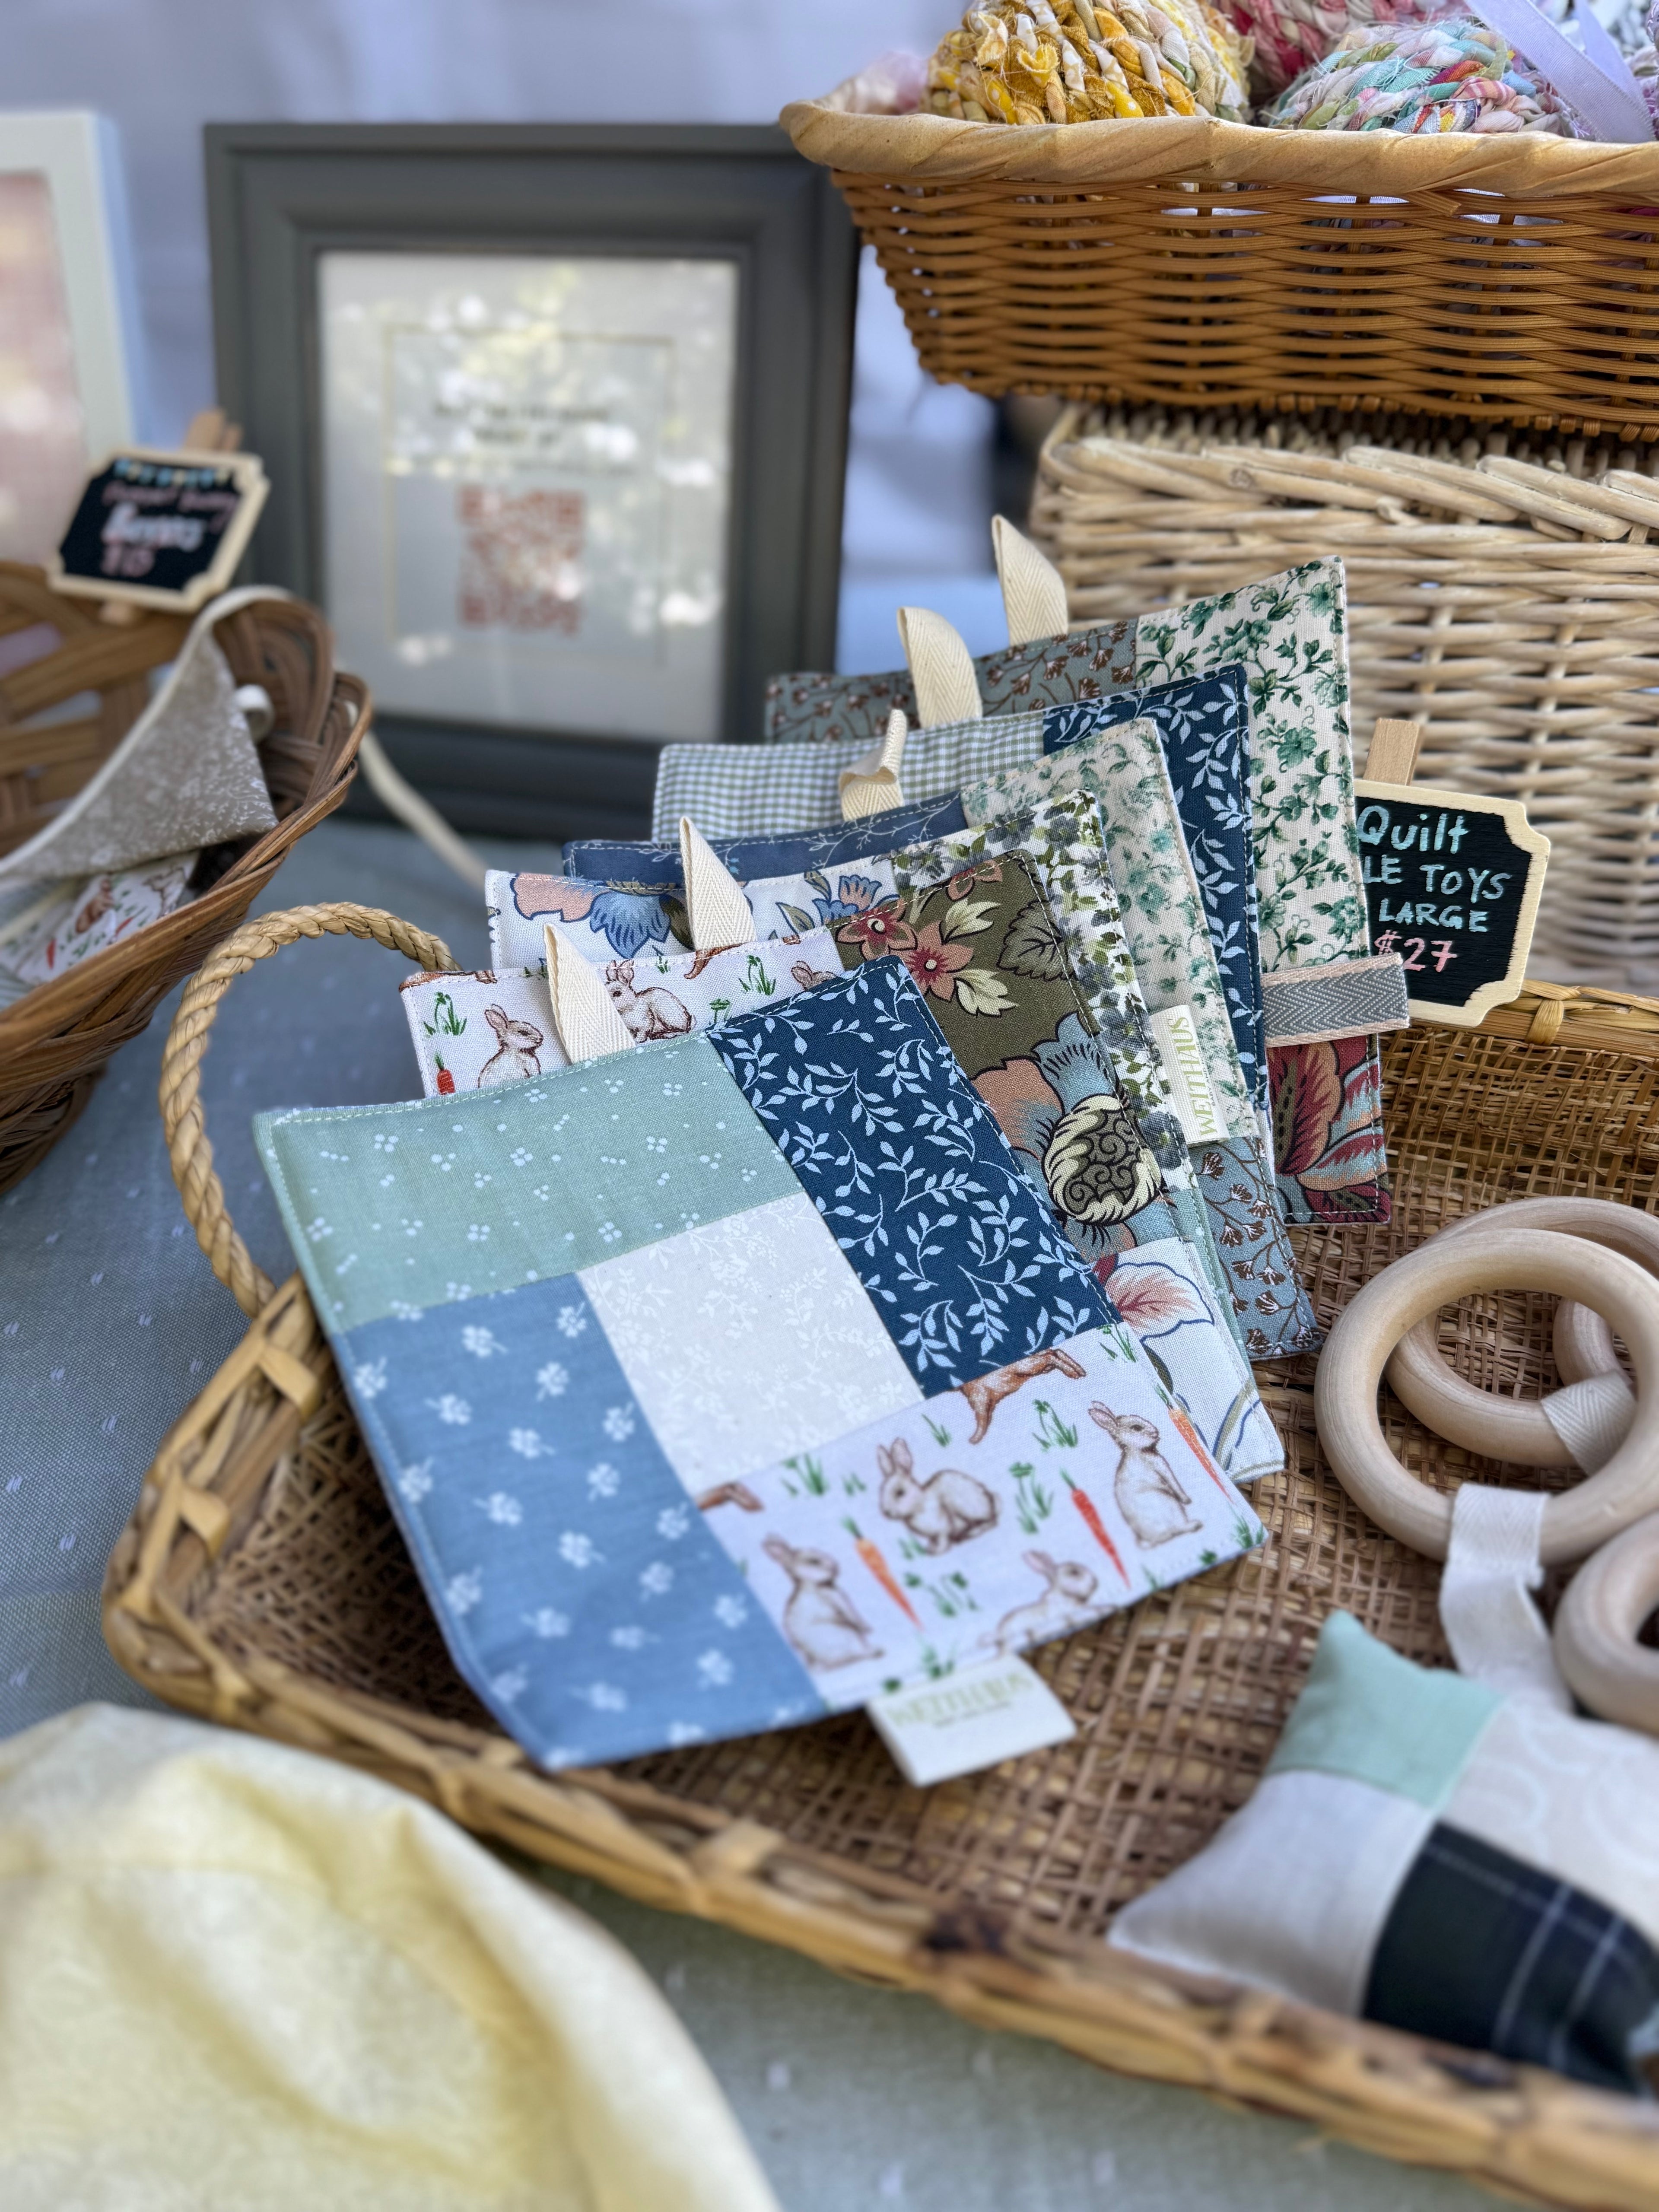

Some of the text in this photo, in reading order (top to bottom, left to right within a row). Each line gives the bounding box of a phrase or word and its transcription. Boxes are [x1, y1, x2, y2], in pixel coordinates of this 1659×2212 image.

[1357, 805, 1468, 854] Quilt
[1419, 864, 1512, 903] TOYS
[1379, 898, 1488, 932] LARGE
[1374, 929, 1458, 972] $27
[1168, 1017, 1217, 1135] WEITHAUS
[1207, 1086, 1216, 1106] BABY
